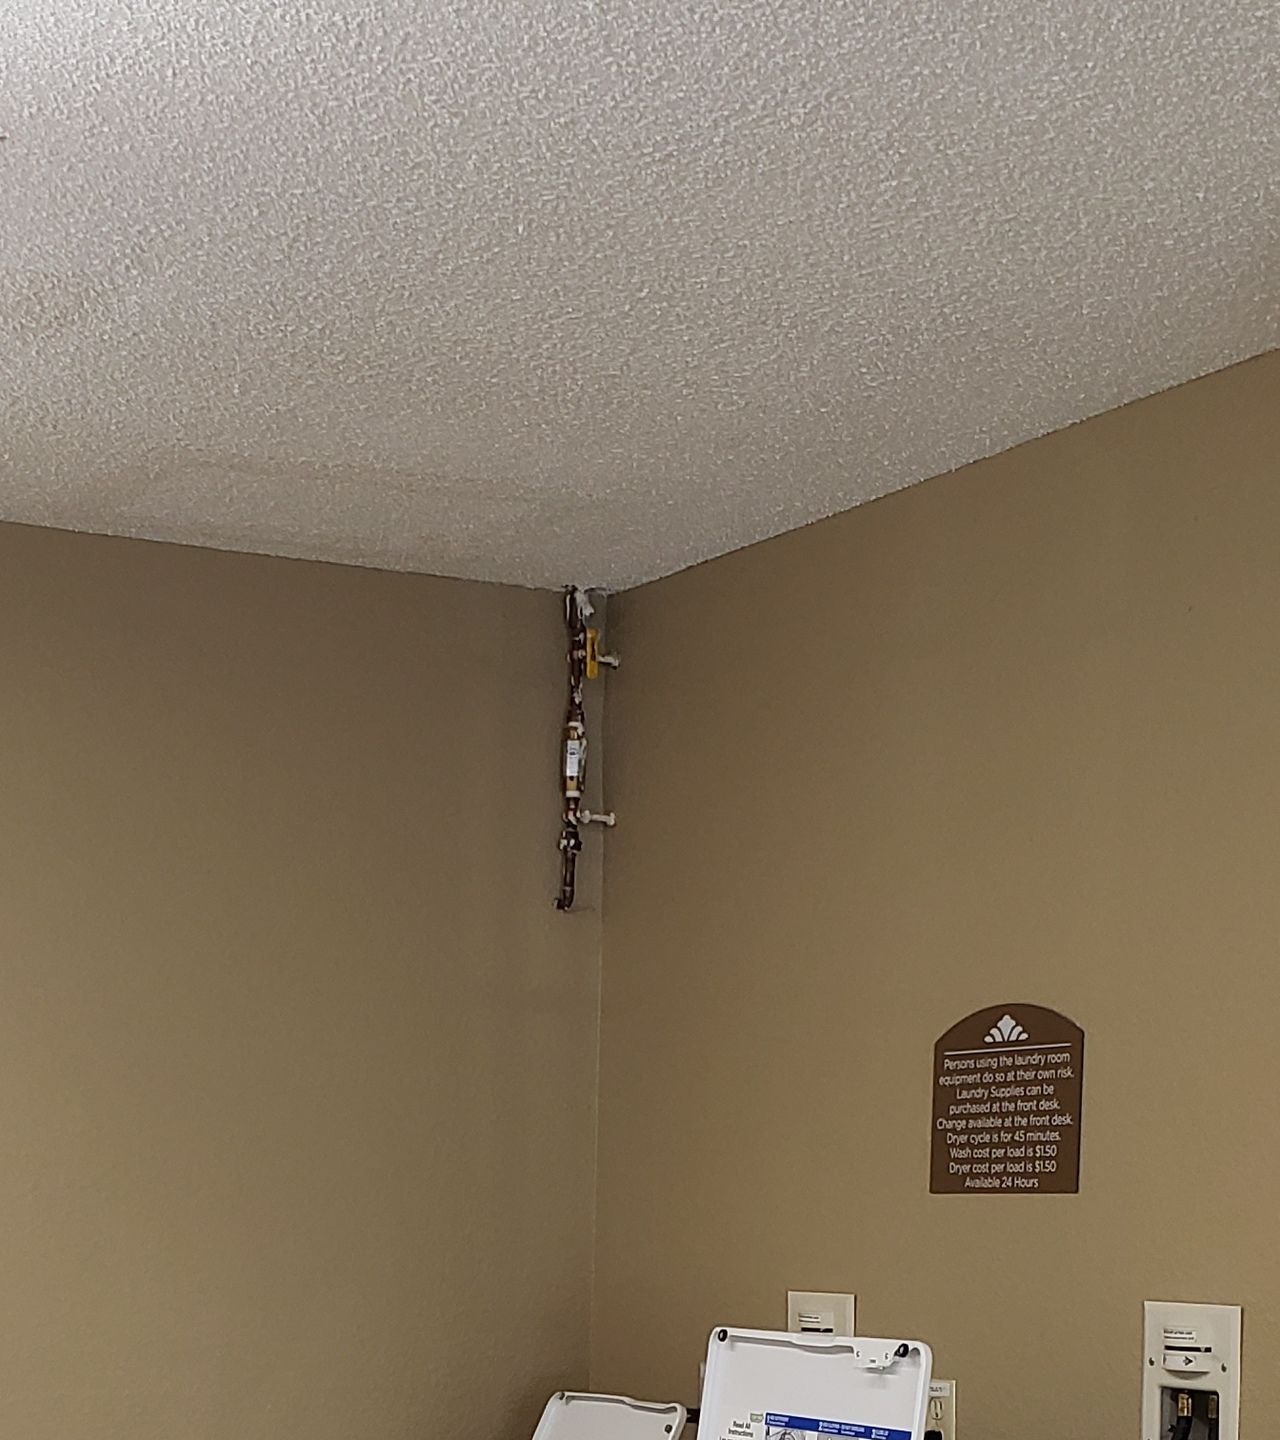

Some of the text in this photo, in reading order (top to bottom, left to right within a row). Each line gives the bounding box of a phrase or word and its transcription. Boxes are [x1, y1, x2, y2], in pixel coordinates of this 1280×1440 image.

[944, 1052, 1070, 1070] Persons using the laundry room
[939, 1067, 1074, 1085] equipment do so at their own risk.
[957, 1084, 1054, 1100] Laundry Supplies can be
[950, 1099, 1060, 1115] purchased at the front desk.
[937, 1113, 1073, 1131] Change available at the front desk.
[947, 1130, 1061, 1146] Dryer cycle is for 45 minutes.
[950, 1144, 1057, 1159] Wash cost per load is $1.50
[949, 1160, 1056, 1175] Dryer cost per load is $1.50
[965, 1176, 1038, 1188] Available 24 Hours
